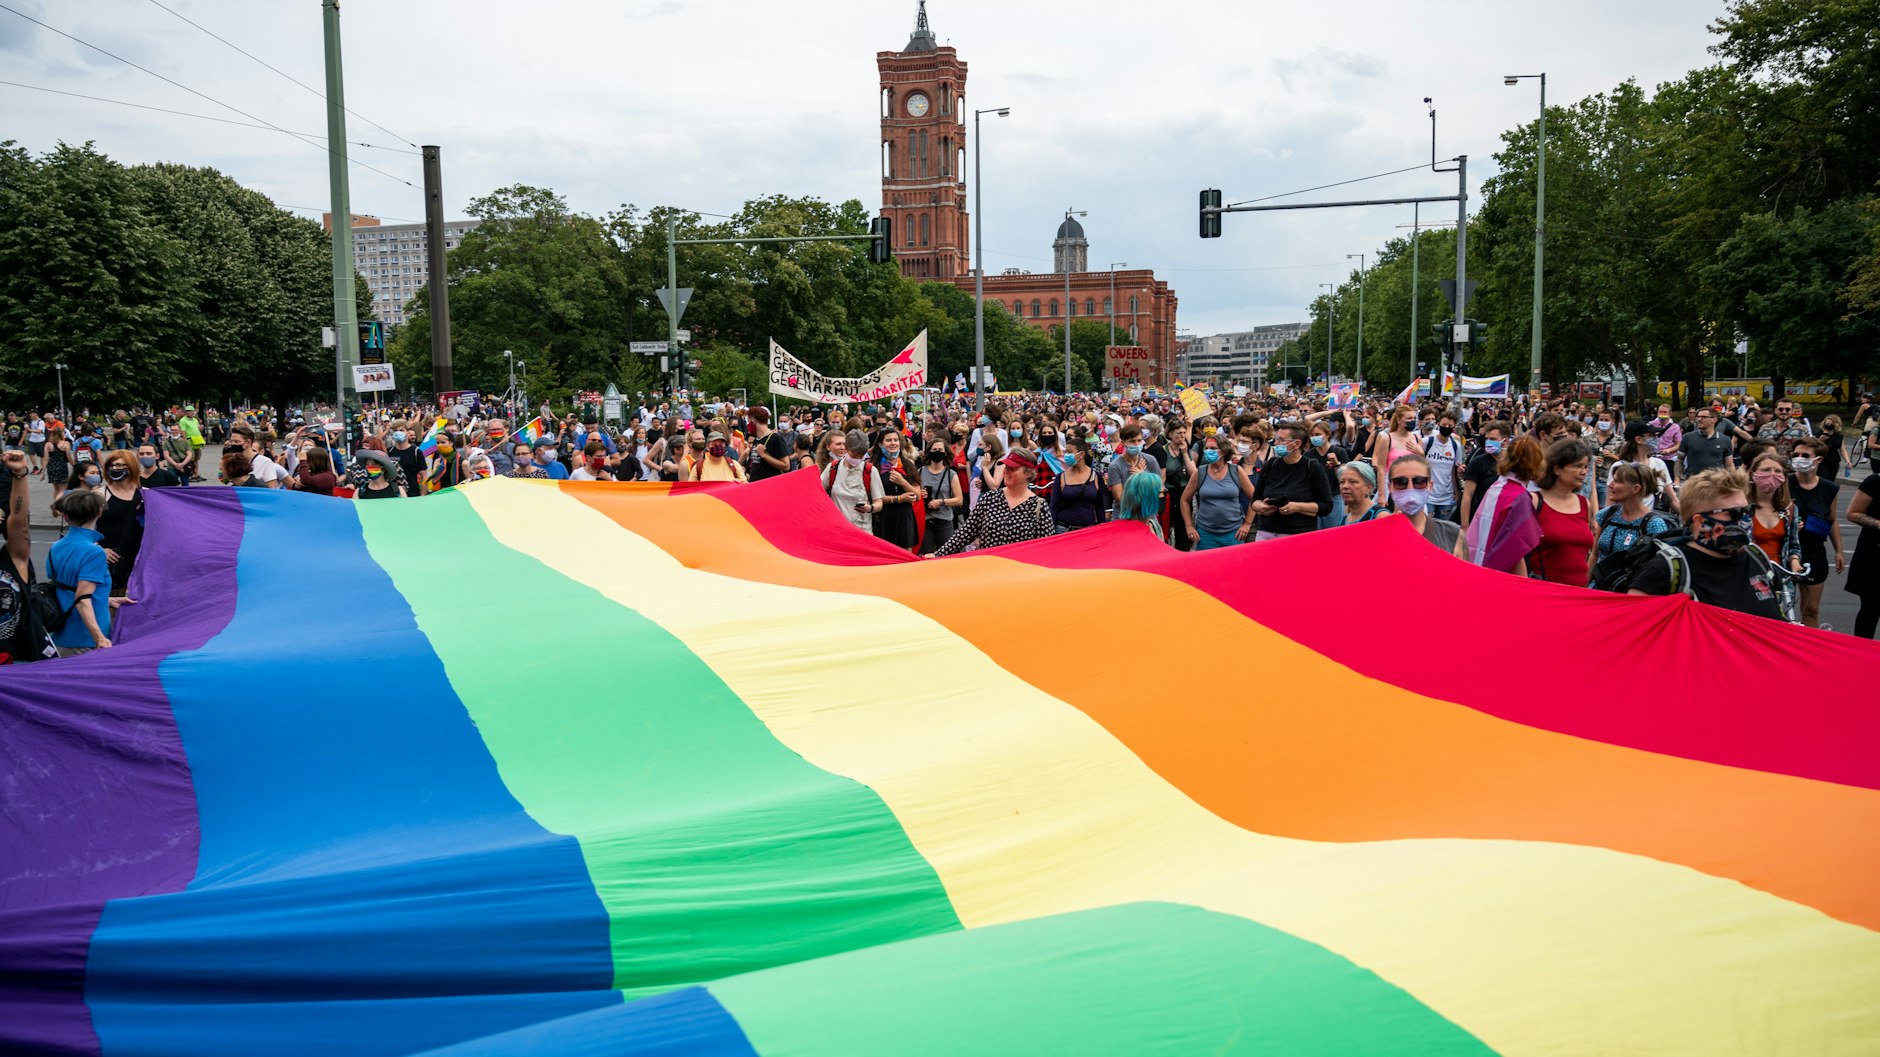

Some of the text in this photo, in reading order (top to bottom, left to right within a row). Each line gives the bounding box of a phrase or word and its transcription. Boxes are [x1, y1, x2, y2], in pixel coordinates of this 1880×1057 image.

[1109, 348, 1148, 360] QUEERS
[773, 356, 811, 380] GEGEN
[1123, 360, 1132, 368] 4
[1113, 366, 1139, 378] BLM
